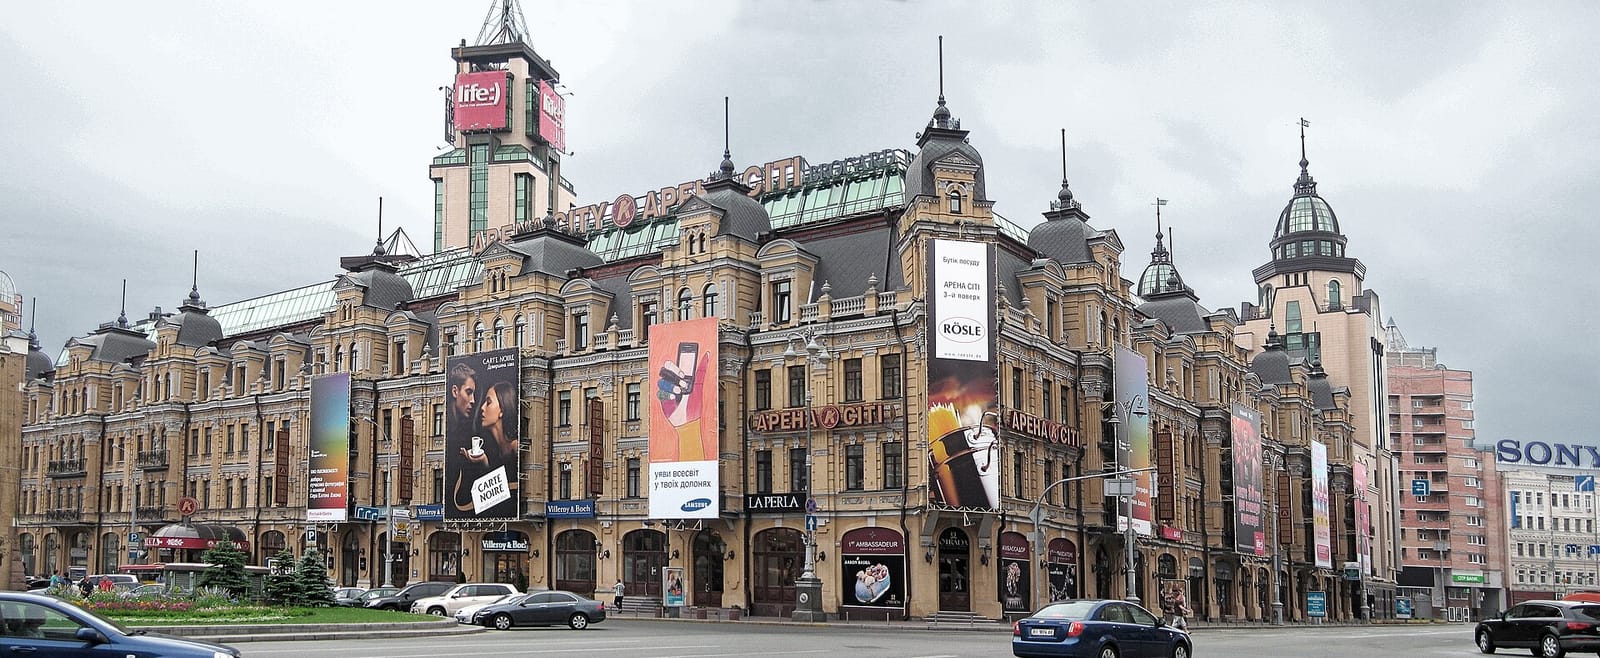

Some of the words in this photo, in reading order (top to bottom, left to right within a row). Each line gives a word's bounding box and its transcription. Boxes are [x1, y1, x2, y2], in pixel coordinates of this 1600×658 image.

[458, 82, 501, 106] life:)
[643, 179, 706, 219] АРЕ
[553, 202, 608, 235] CITY
[943, 256, 958, 264] Бутік
[943, 281, 966, 289] АРЕНА
[967, 282, 981, 291] СІТІ
[943, 322, 981, 336] RÖSLE
[482, 357, 498, 365] CARTE
[757, 410, 817, 431] АРЕНА
[843, 405, 884, 425] СІТІ
[1012, 411, 1048, 439] АРЕНА
[1060, 426, 1080, 447] СІТІ
[1496, 439, 1600, 469] SONY
[654, 471, 672, 480] уяви
[672, 468, 700, 478] всесвіт
[477, 474, 503, 493] CARTE
[654, 482, 659, 491] у
[660, 480, 679, 489] твоїх
[680, 480, 712, 489] долонях
[479, 484, 505, 503] NOIRE
[748, 497, 763, 509] LA
[764, 496, 799, 509] PERLA
[417, 508, 437, 517] Villeroy
[547, 505, 570, 514] Villeroy
[482, 540, 507, 550] Villeroy
